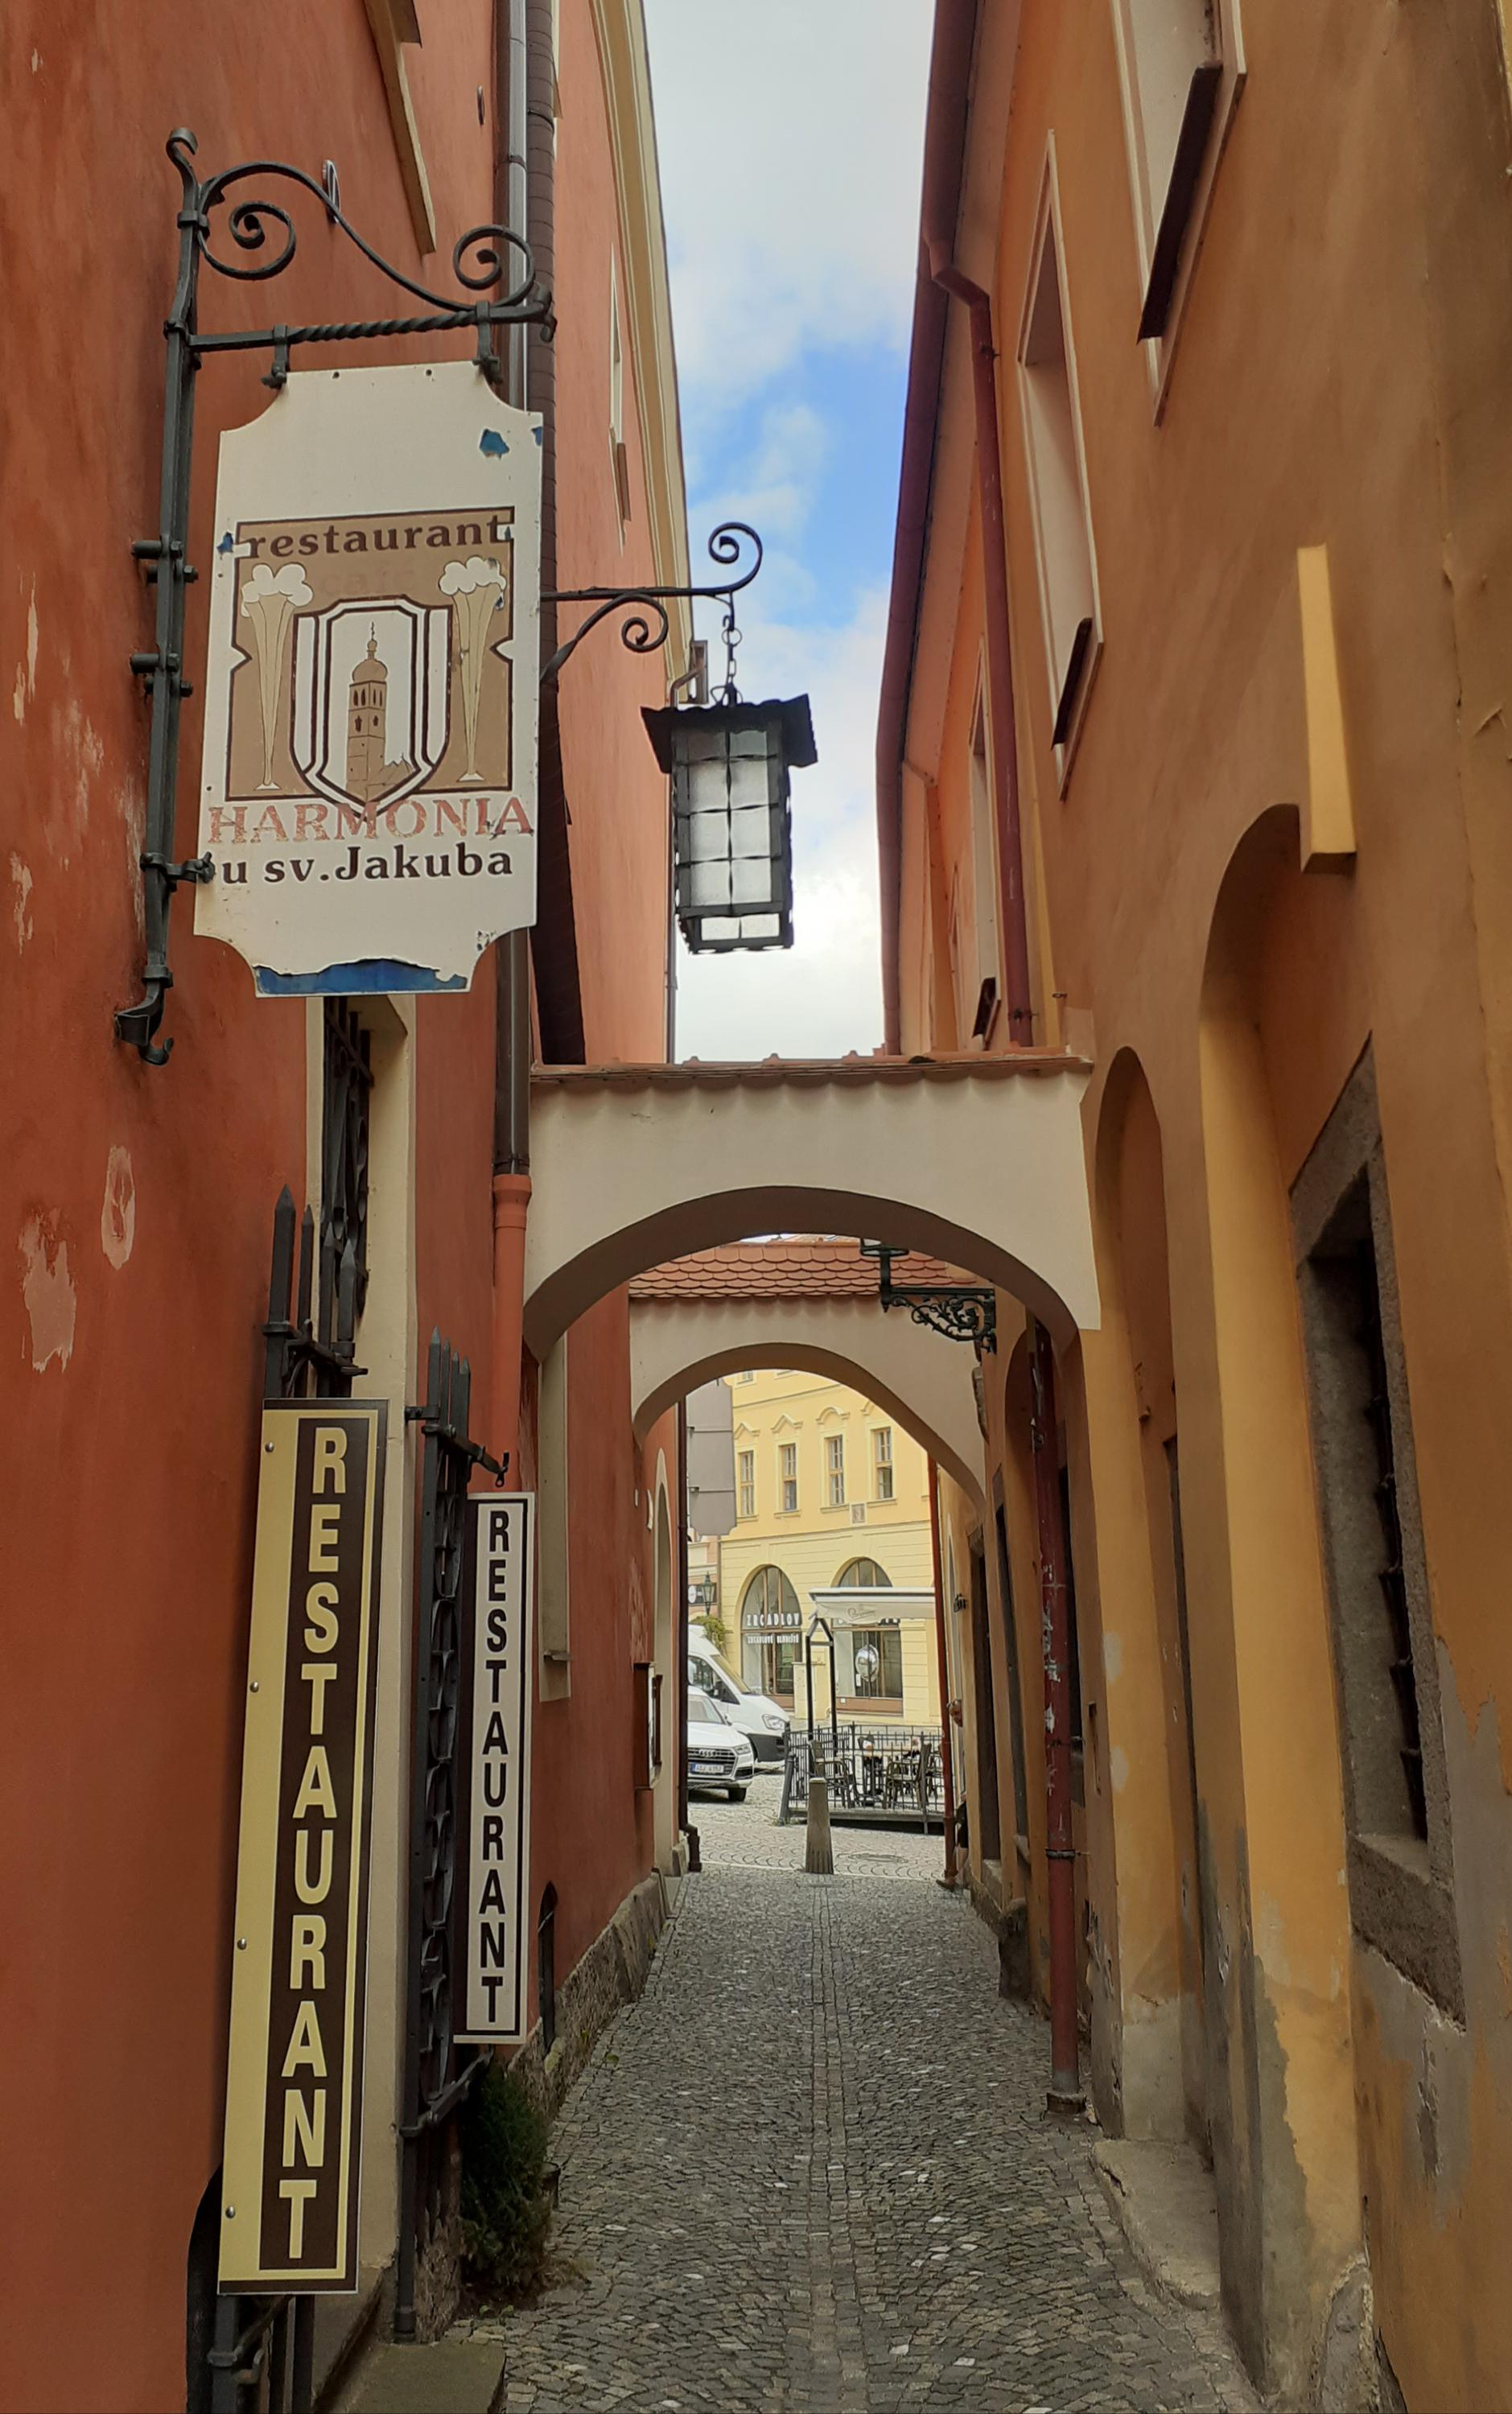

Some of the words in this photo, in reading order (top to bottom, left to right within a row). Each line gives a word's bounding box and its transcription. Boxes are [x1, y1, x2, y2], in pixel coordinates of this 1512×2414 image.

[249, 515, 512, 558] restaurant
[207, 796, 534, 845] HARMONIA
[223, 859, 248, 884] u
[478, 1510, 509, 2025] RESTAURANT
[277, 1426, 348, 2260] RESTAURANT
